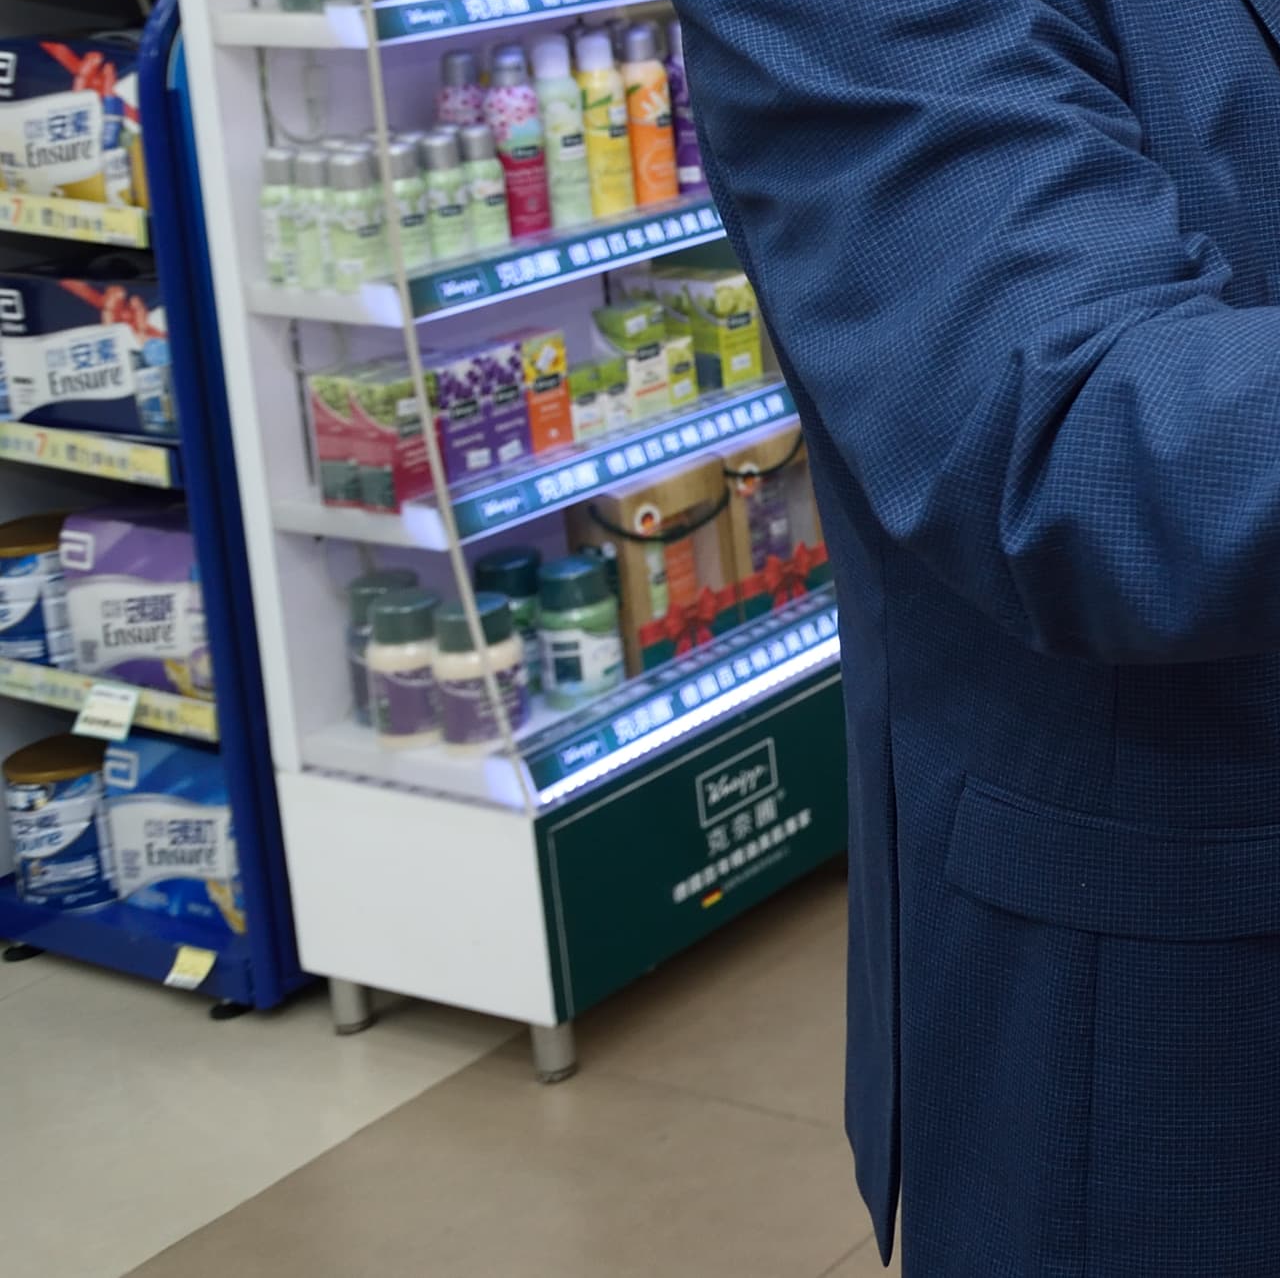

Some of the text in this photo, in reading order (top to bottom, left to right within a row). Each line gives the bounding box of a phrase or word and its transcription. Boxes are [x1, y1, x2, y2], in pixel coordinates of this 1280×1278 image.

[25, 139, 94, 168] Ensure
[568, 208, 724, 264] 德國百年精油美肌
[48, 362, 125, 397] Ensure
[103, 621, 176, 650] Ensure
[145, 838, 218, 868] Ensure
